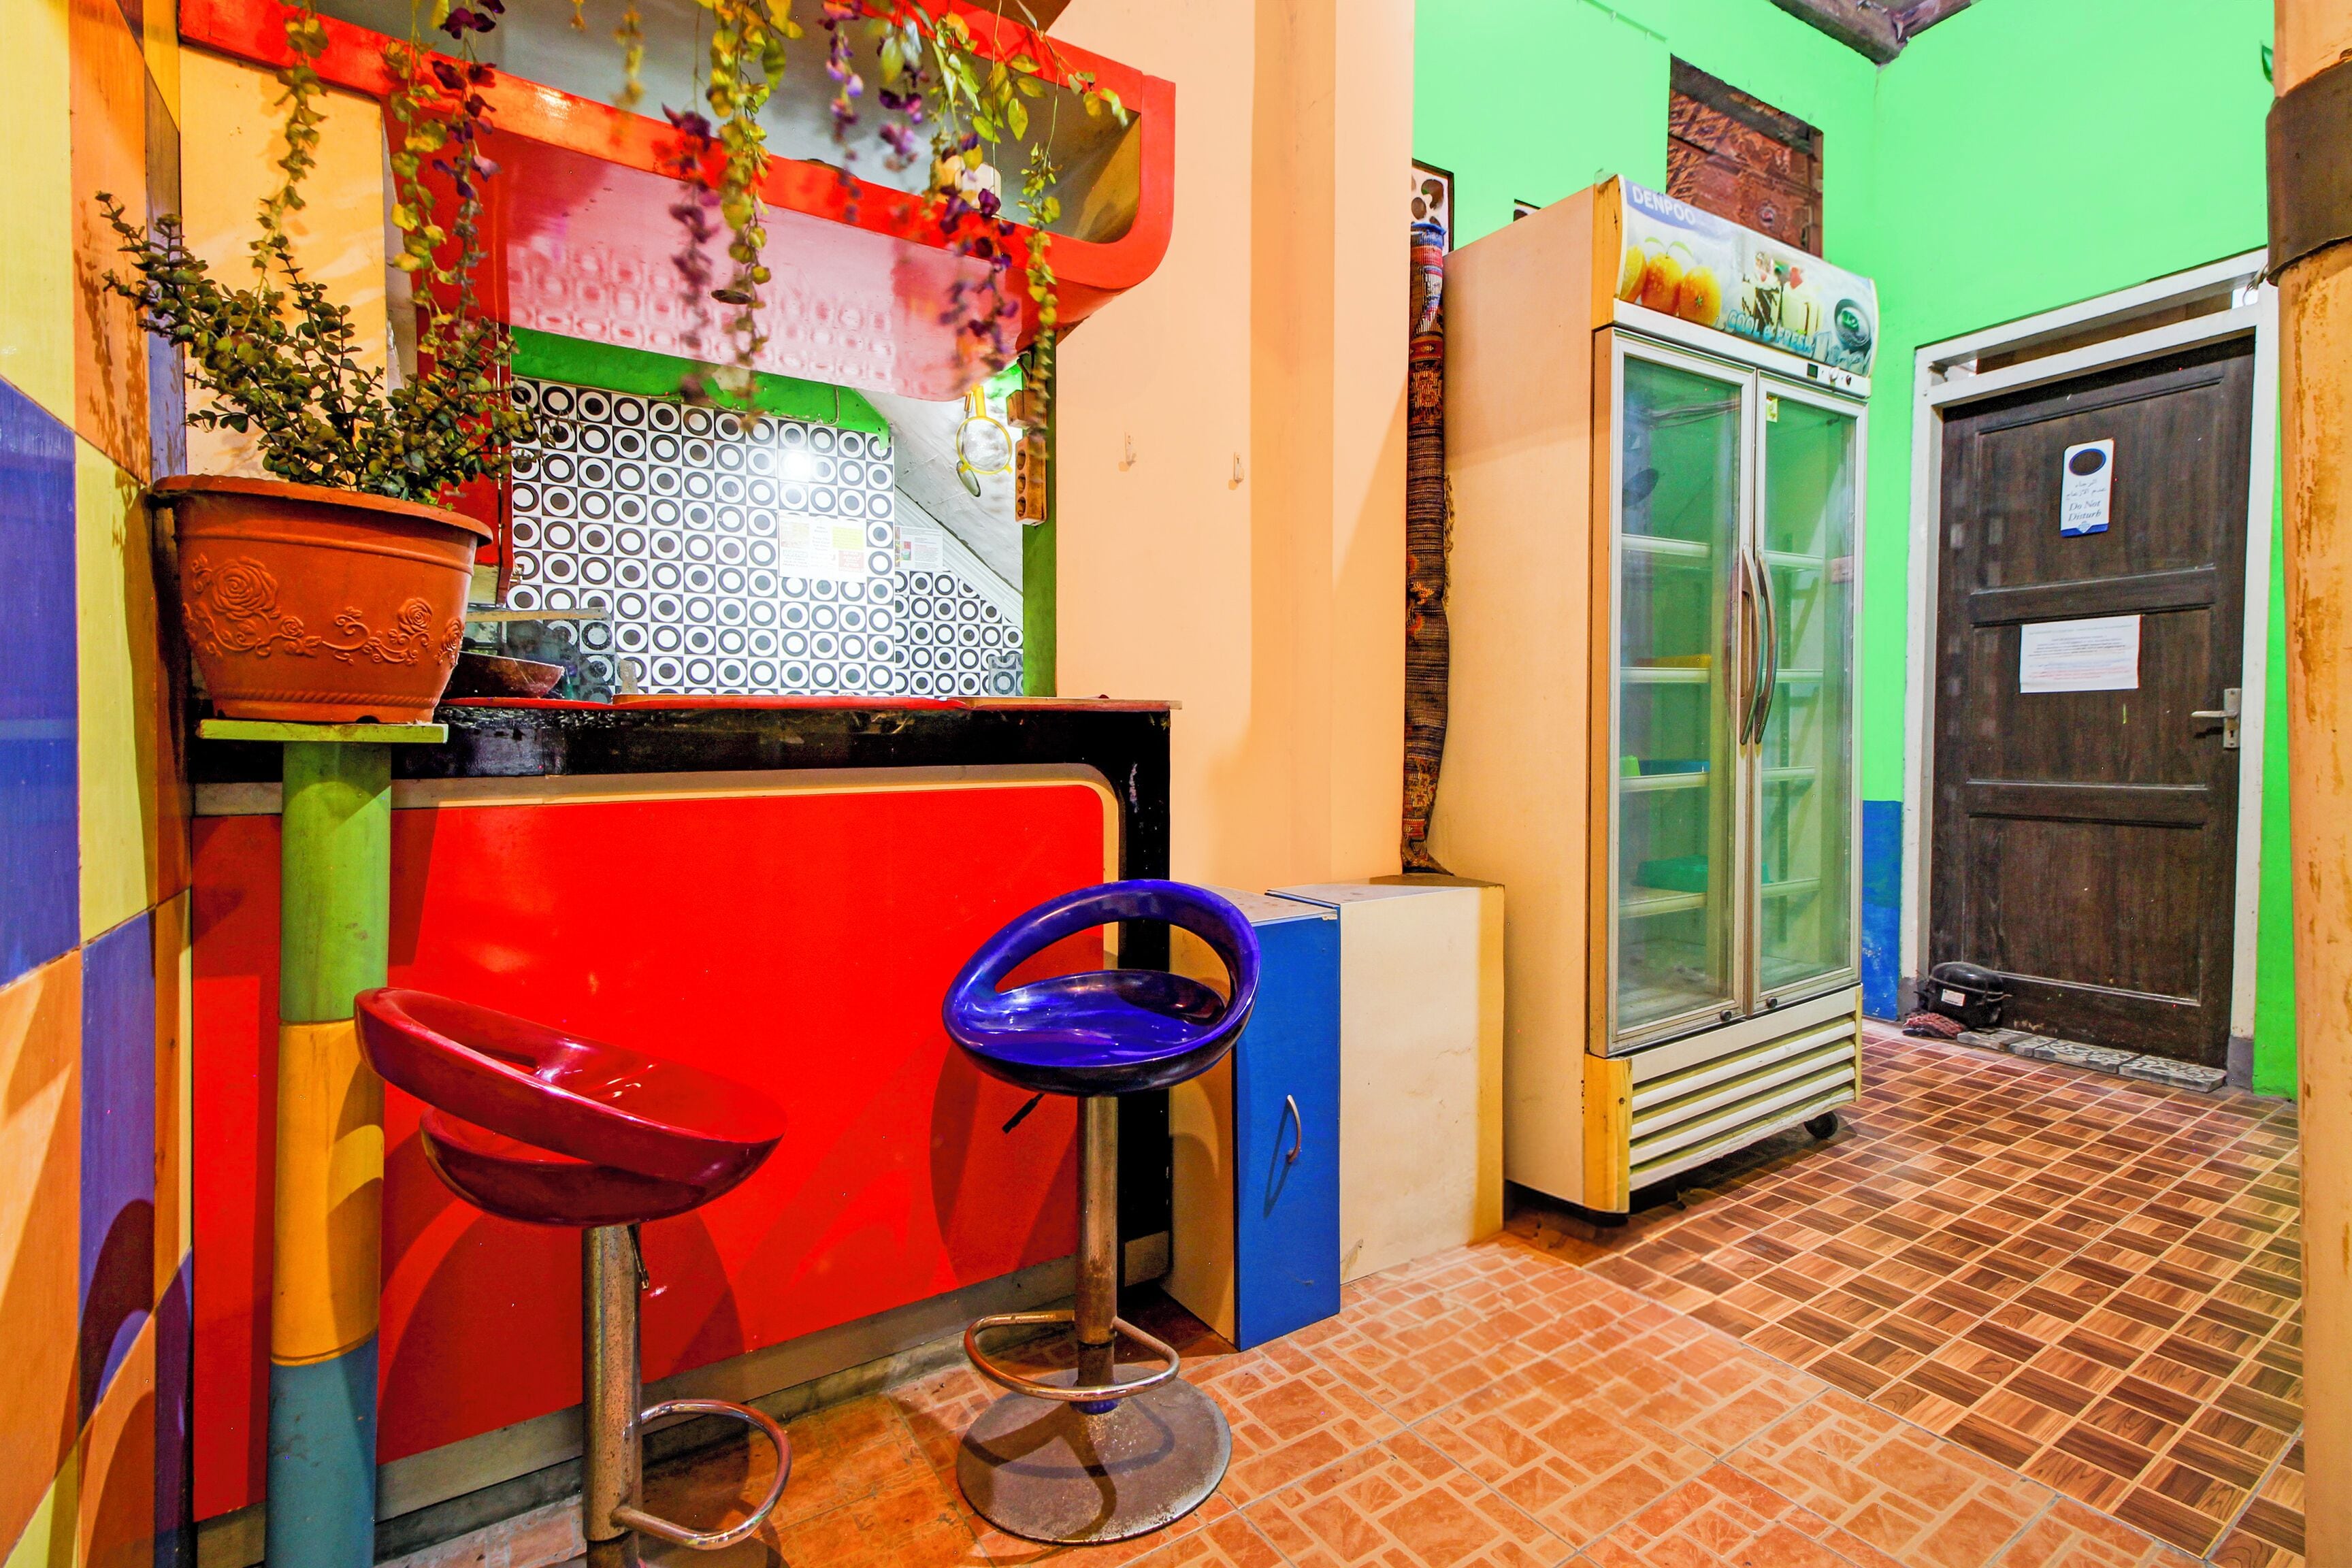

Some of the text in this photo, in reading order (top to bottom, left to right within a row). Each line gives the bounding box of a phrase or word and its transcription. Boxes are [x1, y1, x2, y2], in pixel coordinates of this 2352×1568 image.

[1633, 186, 1695, 225] DENPOO
[1727, 309, 1761, 338] COOL
[1775, 328, 1814, 355] FRESH
[2068, 509, 2102, 521] Disturb
[2069, 500, 2101, 511] Do Not
